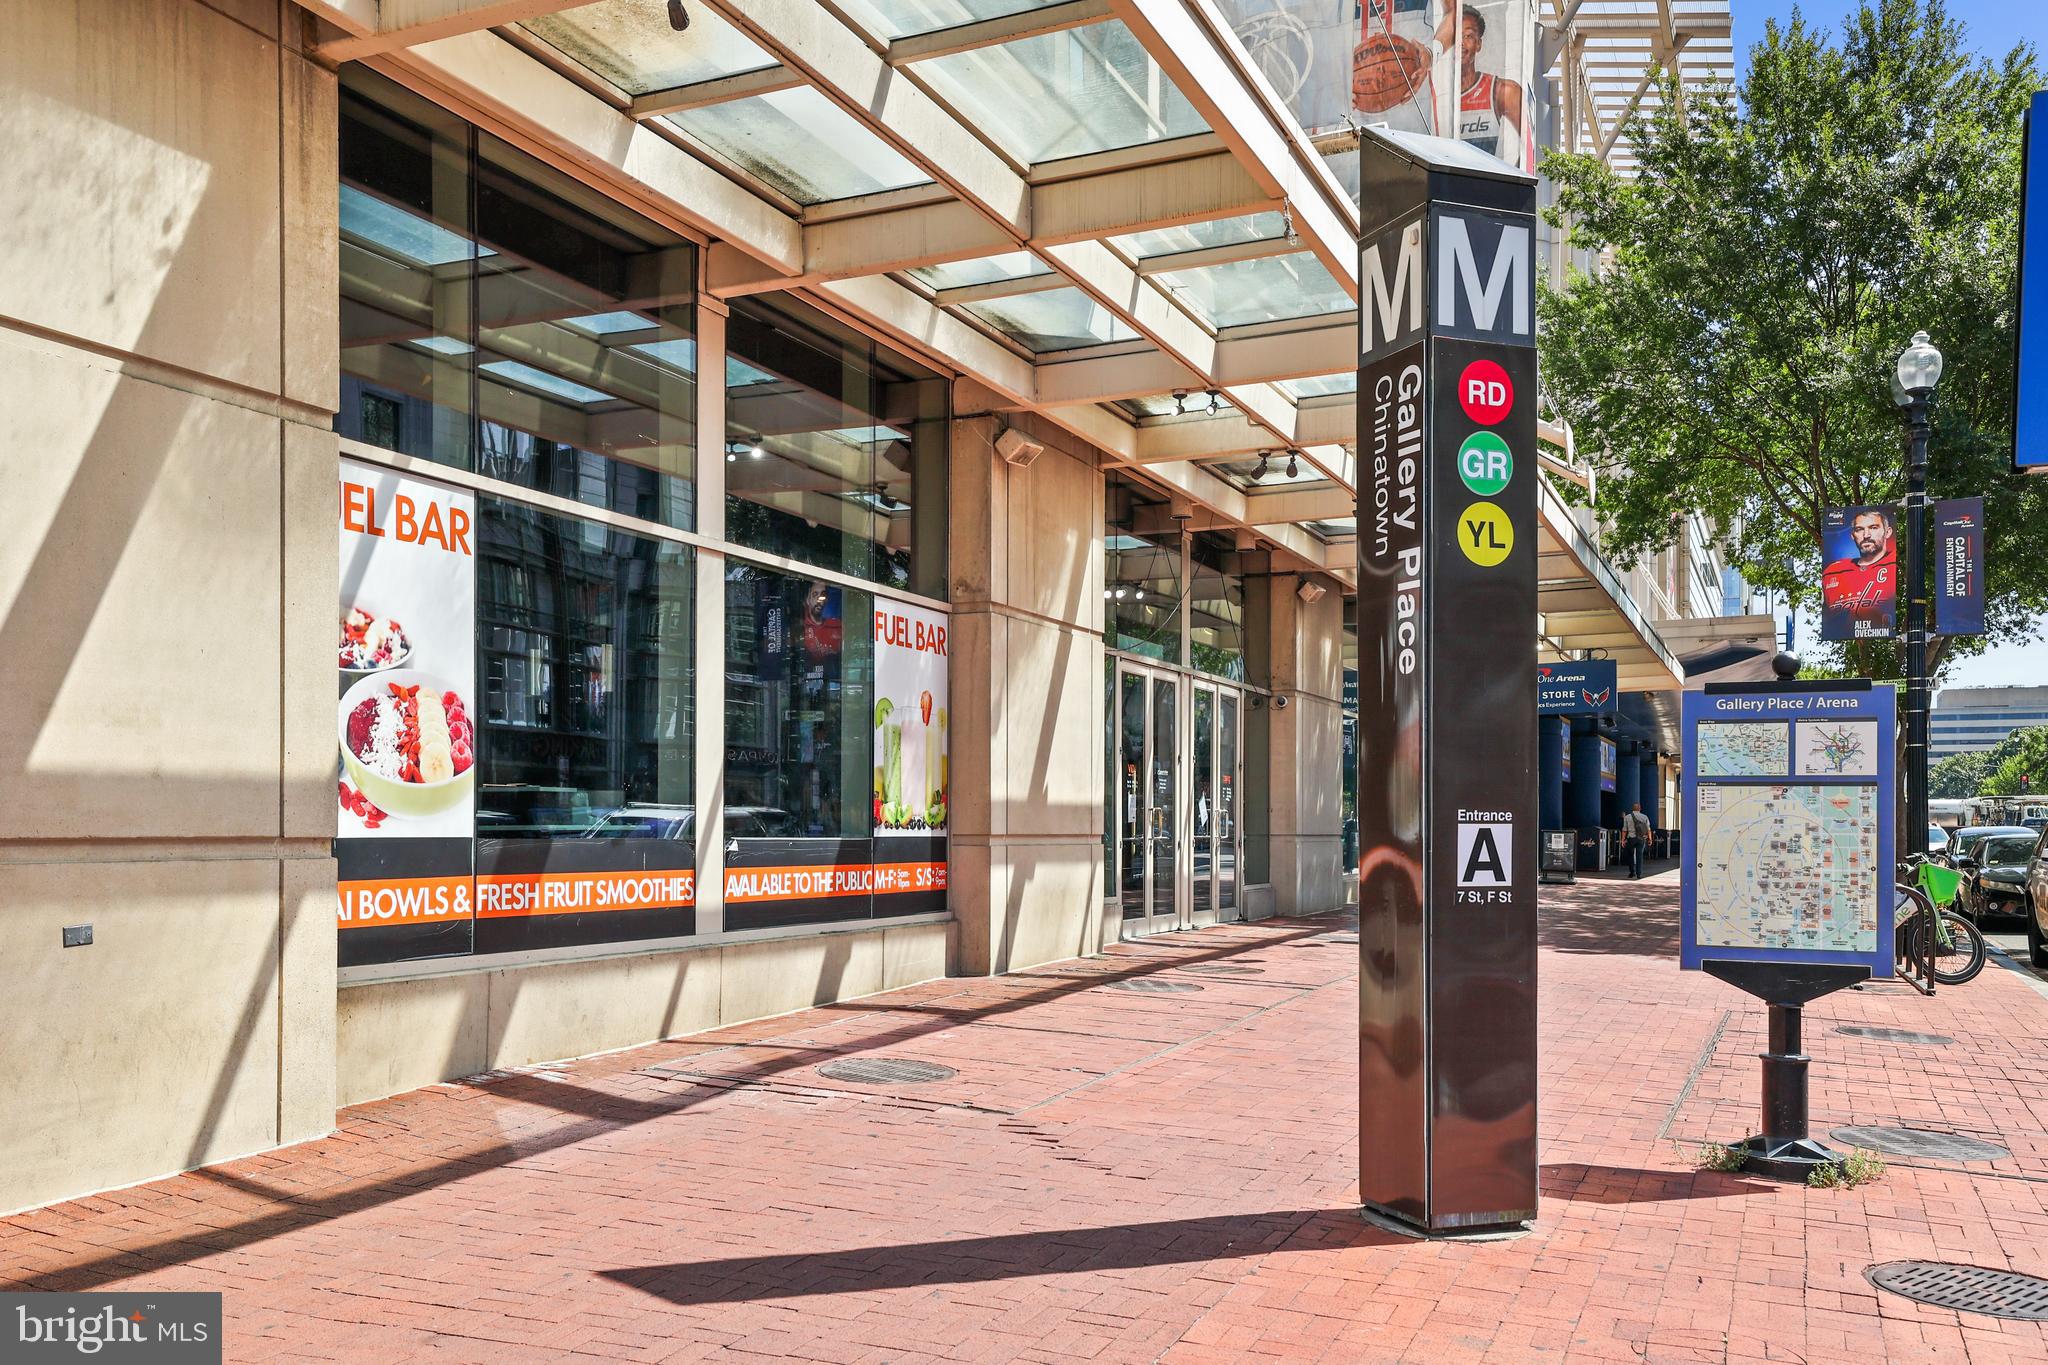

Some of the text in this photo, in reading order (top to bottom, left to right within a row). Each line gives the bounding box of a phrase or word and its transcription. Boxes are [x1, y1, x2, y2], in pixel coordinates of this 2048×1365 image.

[1361, 219, 1423, 354] M
[1438, 215, 1530, 335] M
[1467, 379, 1506, 407] RD
[1374, 375, 1393, 557] Chinatown
[1462, 449, 1508, 480] GR
[339, 481, 472, 555] EL BAR
[1393, 364, 1422, 675] Gallery Place
[1466, 520, 1506, 549] YL
[1946, 537, 1954, 597] ENTERTAINMENT
[1955, 536, 1966, 597] CAPITAL OF
[875, 610, 947, 657] FUEL BAR
[1854, 620, 1872, 629] ALEX
[1854, 629, 1889, 637] OVECHKIN
[1542, 690, 1576, 699] STORE
[1716, 698, 1764, 712] Gallery
[1768, 697, 1804, 710] Place
[1816, 697, 1858, 709] Arena
[1457, 809, 1513, 821] Entrance
[1462, 828, 1507, 882] A
[359, 885, 449, 920] BOWLS
[453, 885, 471, 913] &
[477, 883, 540, 912] FRESH
[544, 880, 593, 908] FRUIT
[595, 876, 694, 906] SMOOTHIES
[725, 870, 873, 898] AVAILABLE TO THE PUBLIC
[1457, 891, 1512, 905] 7 St, F St
